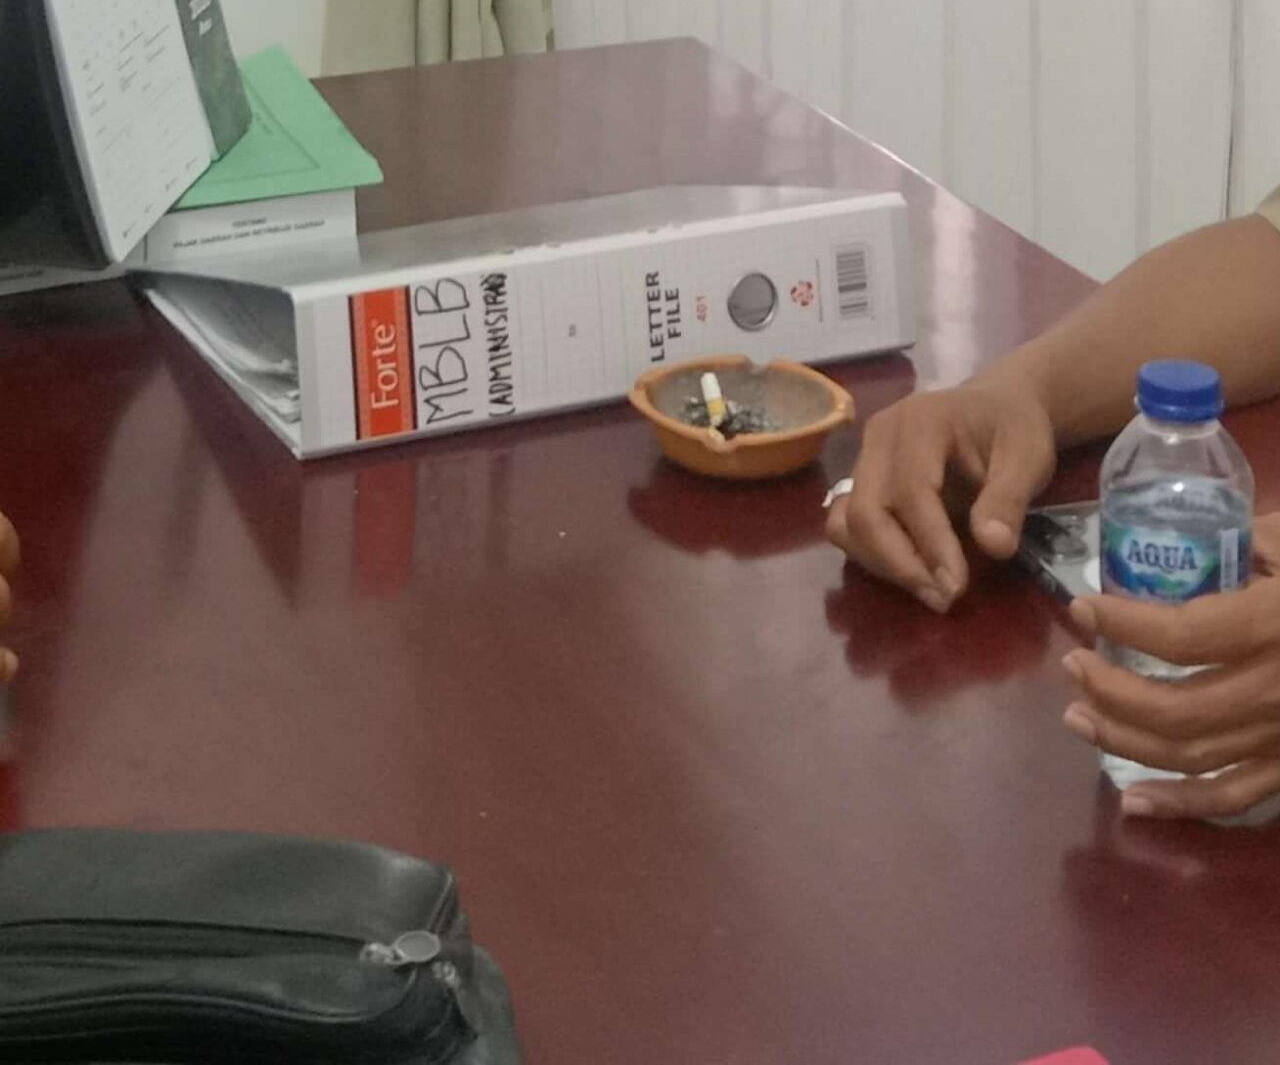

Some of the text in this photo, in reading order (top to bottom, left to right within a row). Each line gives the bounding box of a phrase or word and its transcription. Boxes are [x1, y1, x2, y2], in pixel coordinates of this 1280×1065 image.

[415, 277, 474, 424] MBLB
[644, 270, 665, 362] LETTER
[665, 287, 682, 339] FILE
[371, 323, 400, 410] Forte
[1126, 538, 1197, 574] AQUA
